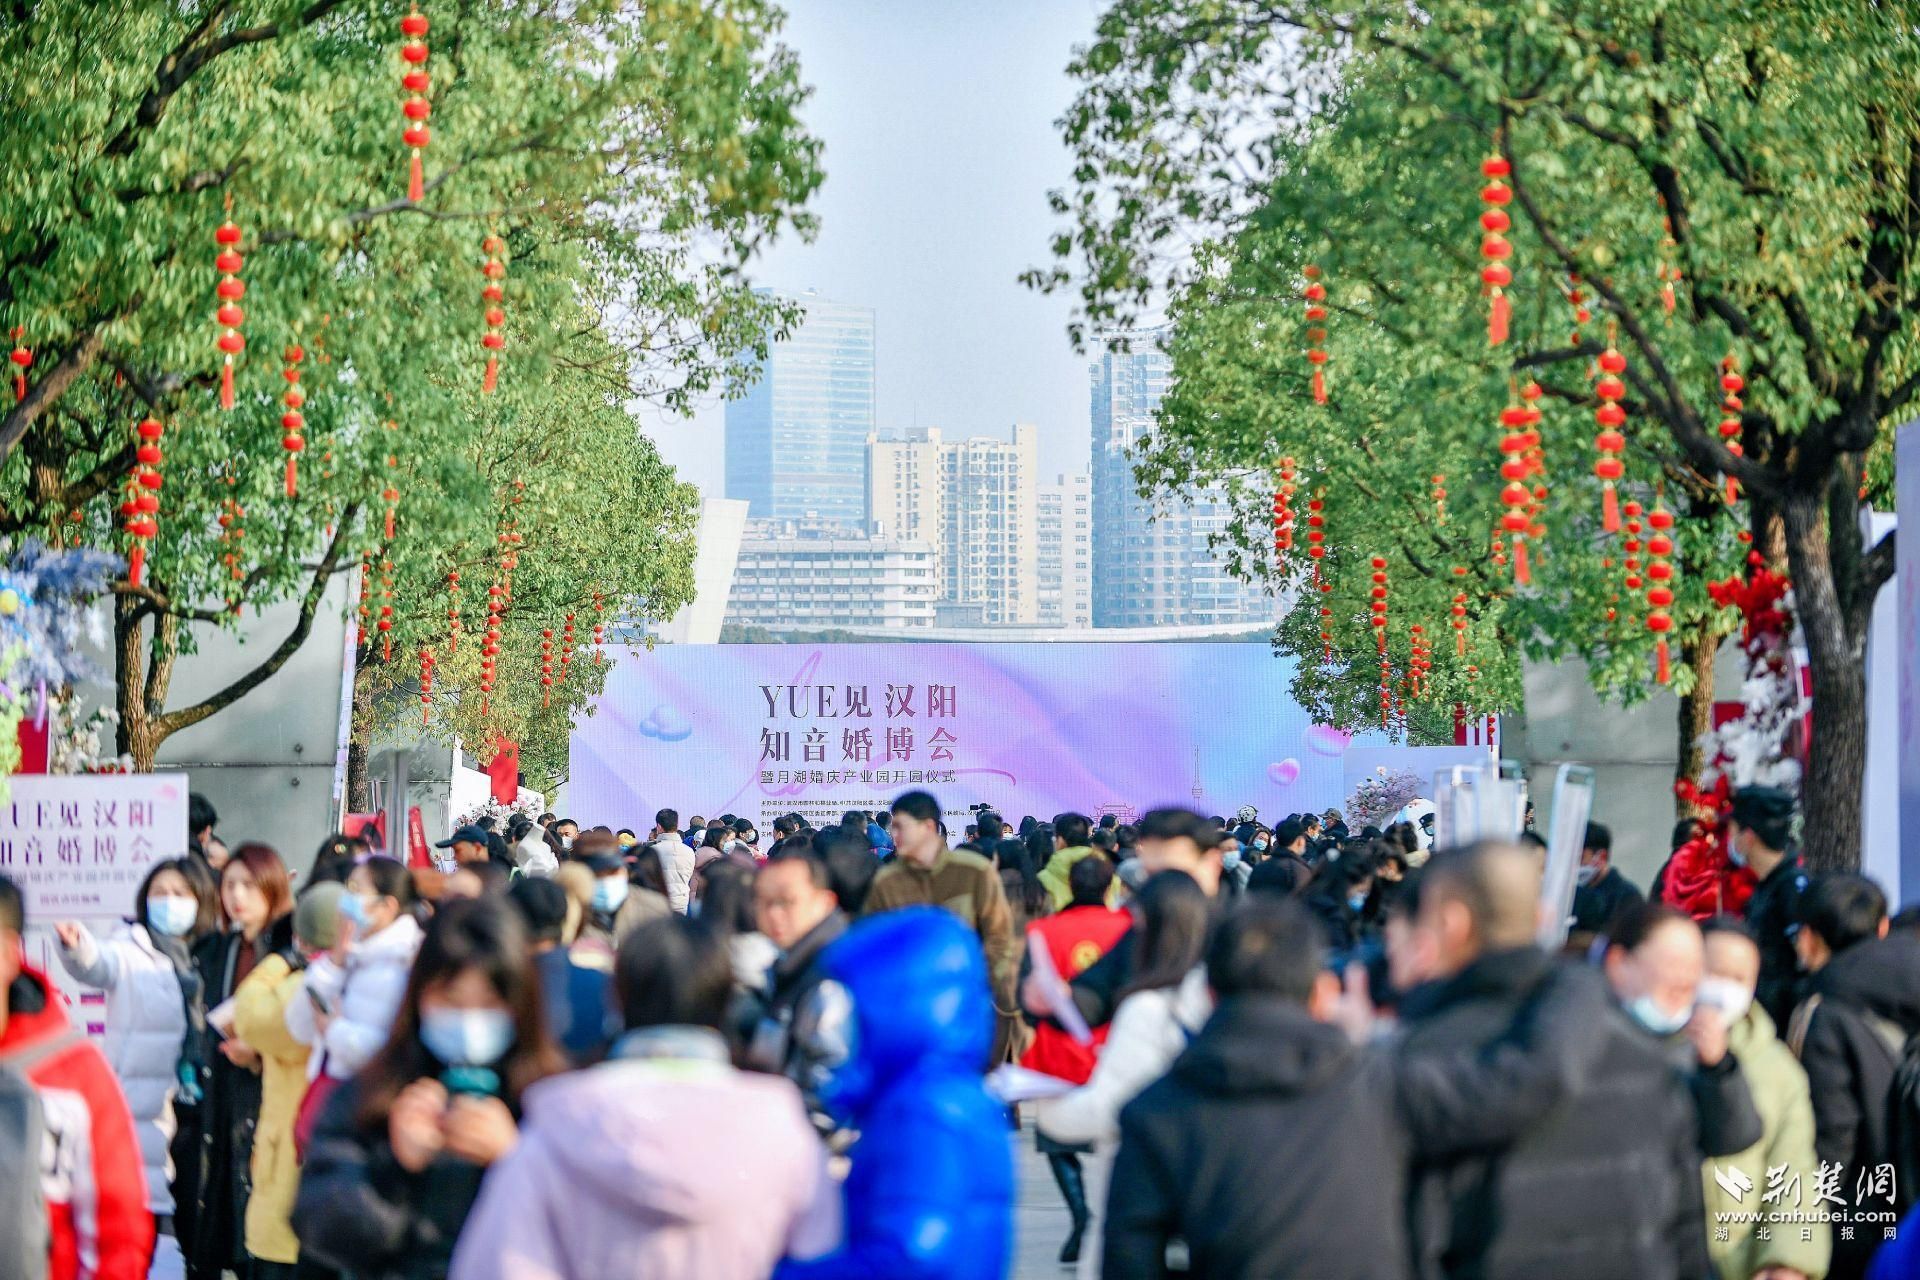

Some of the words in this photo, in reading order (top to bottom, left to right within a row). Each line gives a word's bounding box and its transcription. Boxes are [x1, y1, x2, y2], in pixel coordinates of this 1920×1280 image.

[759, 684, 957, 718] YUE见汉阳
[760, 727, 957, 762] 知音婚博会
[760, 769, 956, 784] 暨月湖婚庆产业园开园仪式
